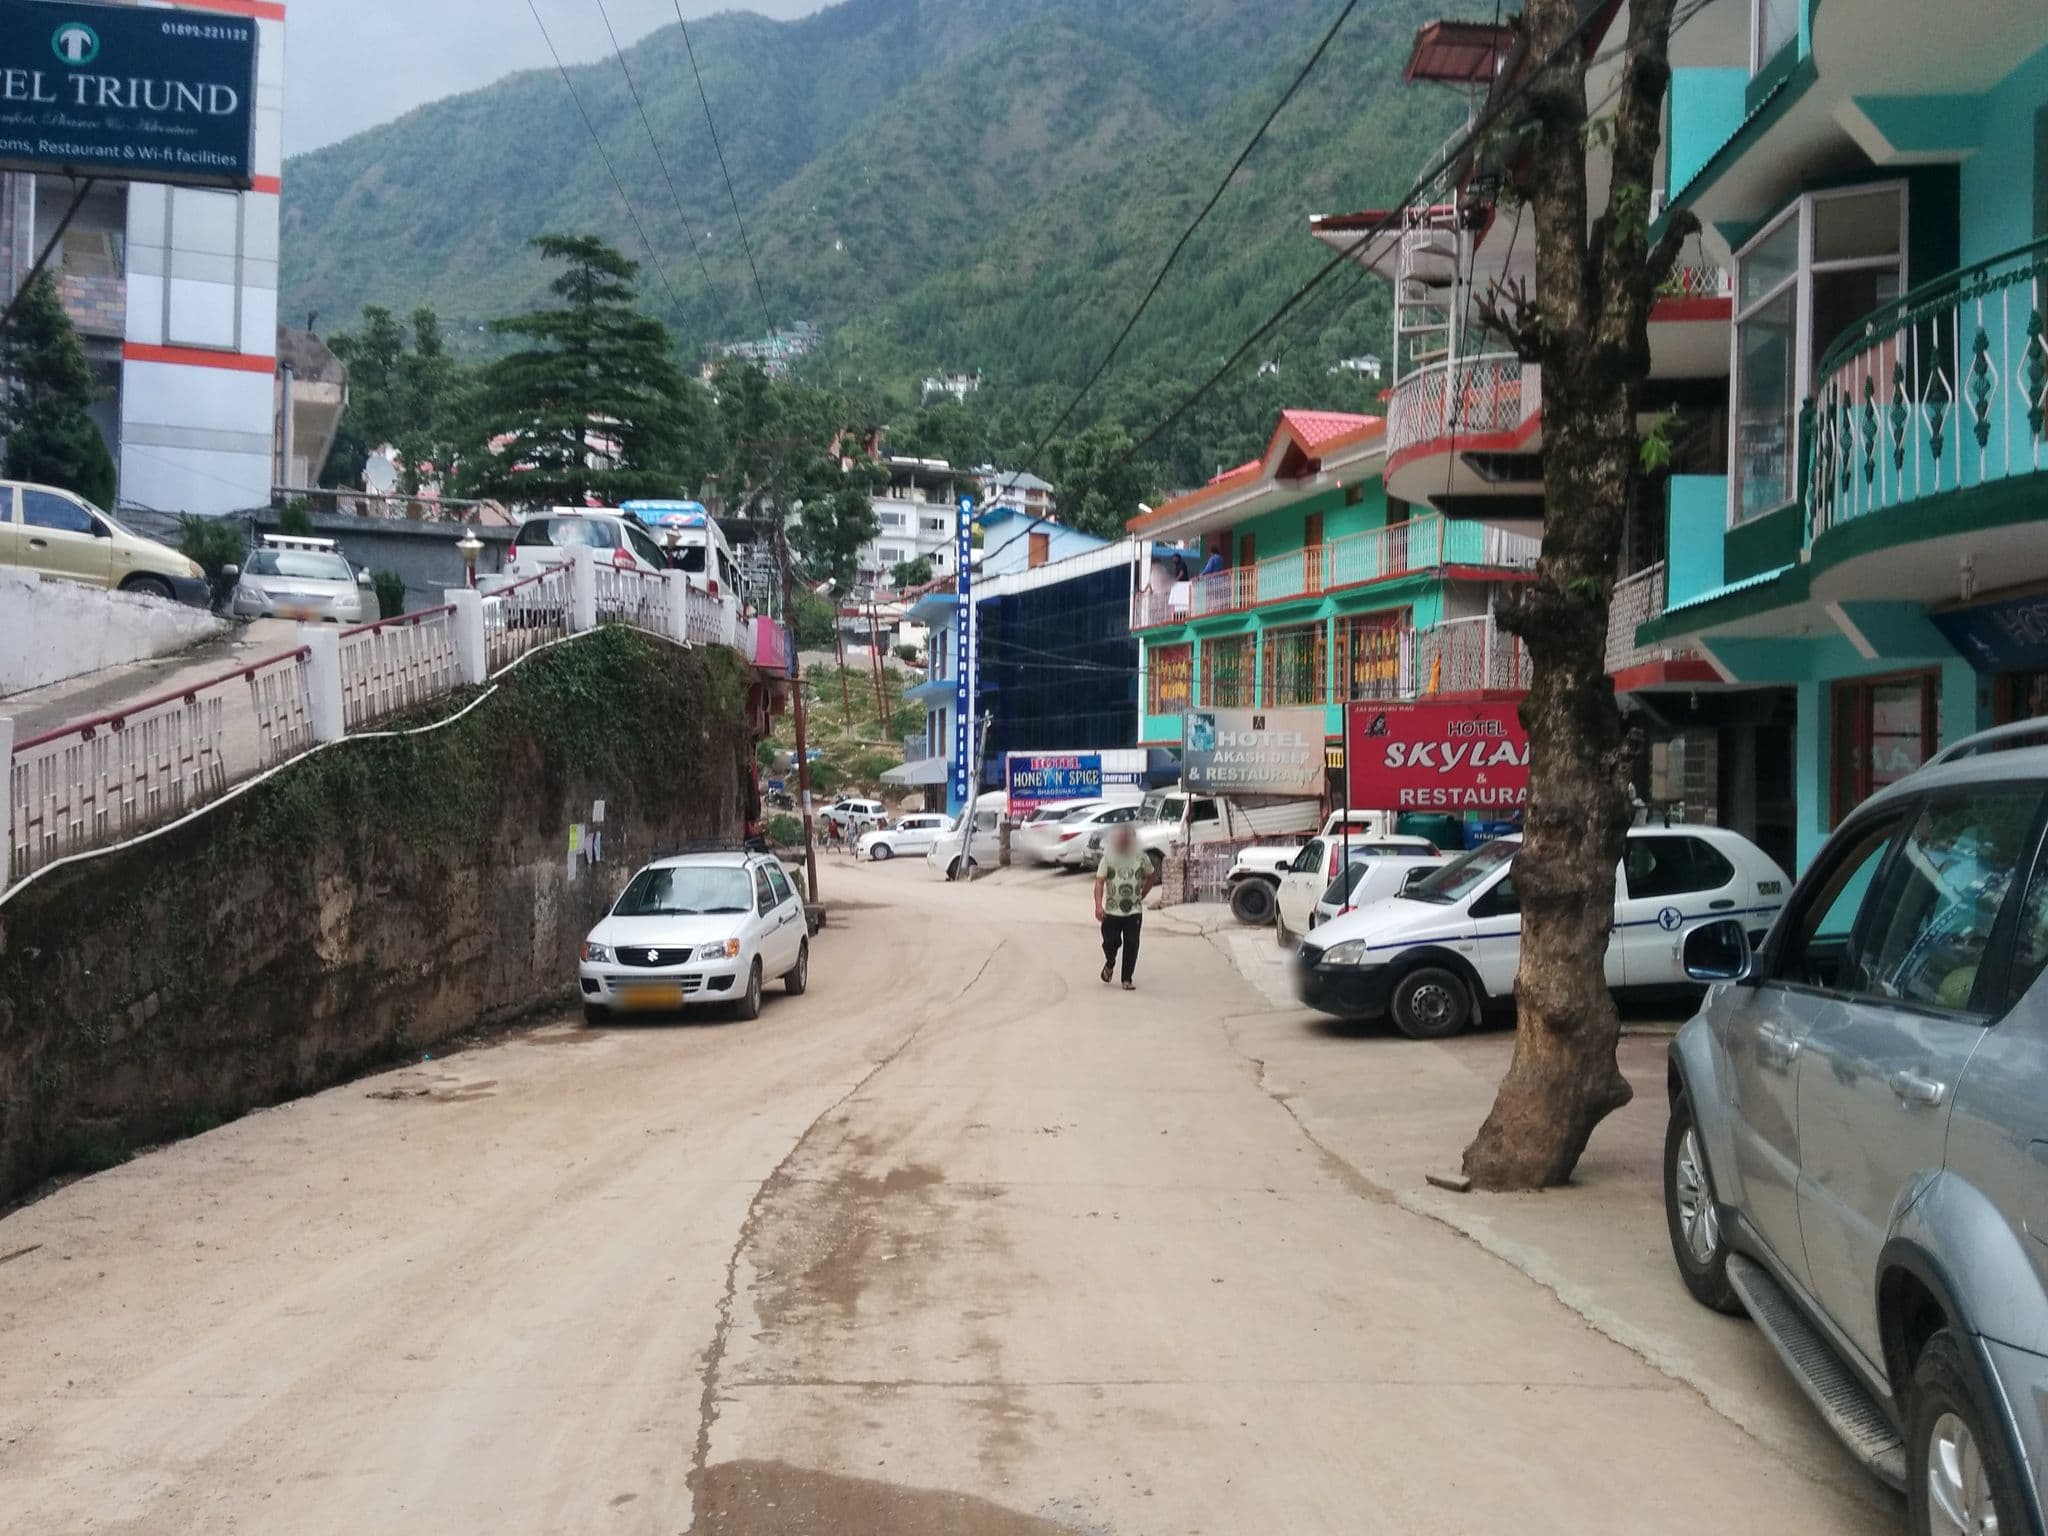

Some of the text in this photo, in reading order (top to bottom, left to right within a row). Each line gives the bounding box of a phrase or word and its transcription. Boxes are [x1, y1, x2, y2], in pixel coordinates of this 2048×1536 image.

[0, 67, 239, 115] EL TRIUND
[39, 138, 120, 158] Restaurant
[123, 144, 135, 160] &
[138, 145, 173, 161] Wi-fi
[177, 146, 238, 167] facilities
[1448, 720, 1507, 737] HOTEL
[1217, 731, 1310, 747] HOTEL
[1031, 757, 1082, 770] HOTEL
[1213, 751, 1265, 763] AKASH
[1013, 769, 1049, 788] HONEY
[1069, 769, 1100, 785] SPICE
[1188, 766, 1317, 783] & RESTAURANT
[1476, 772, 1487, 784] &
